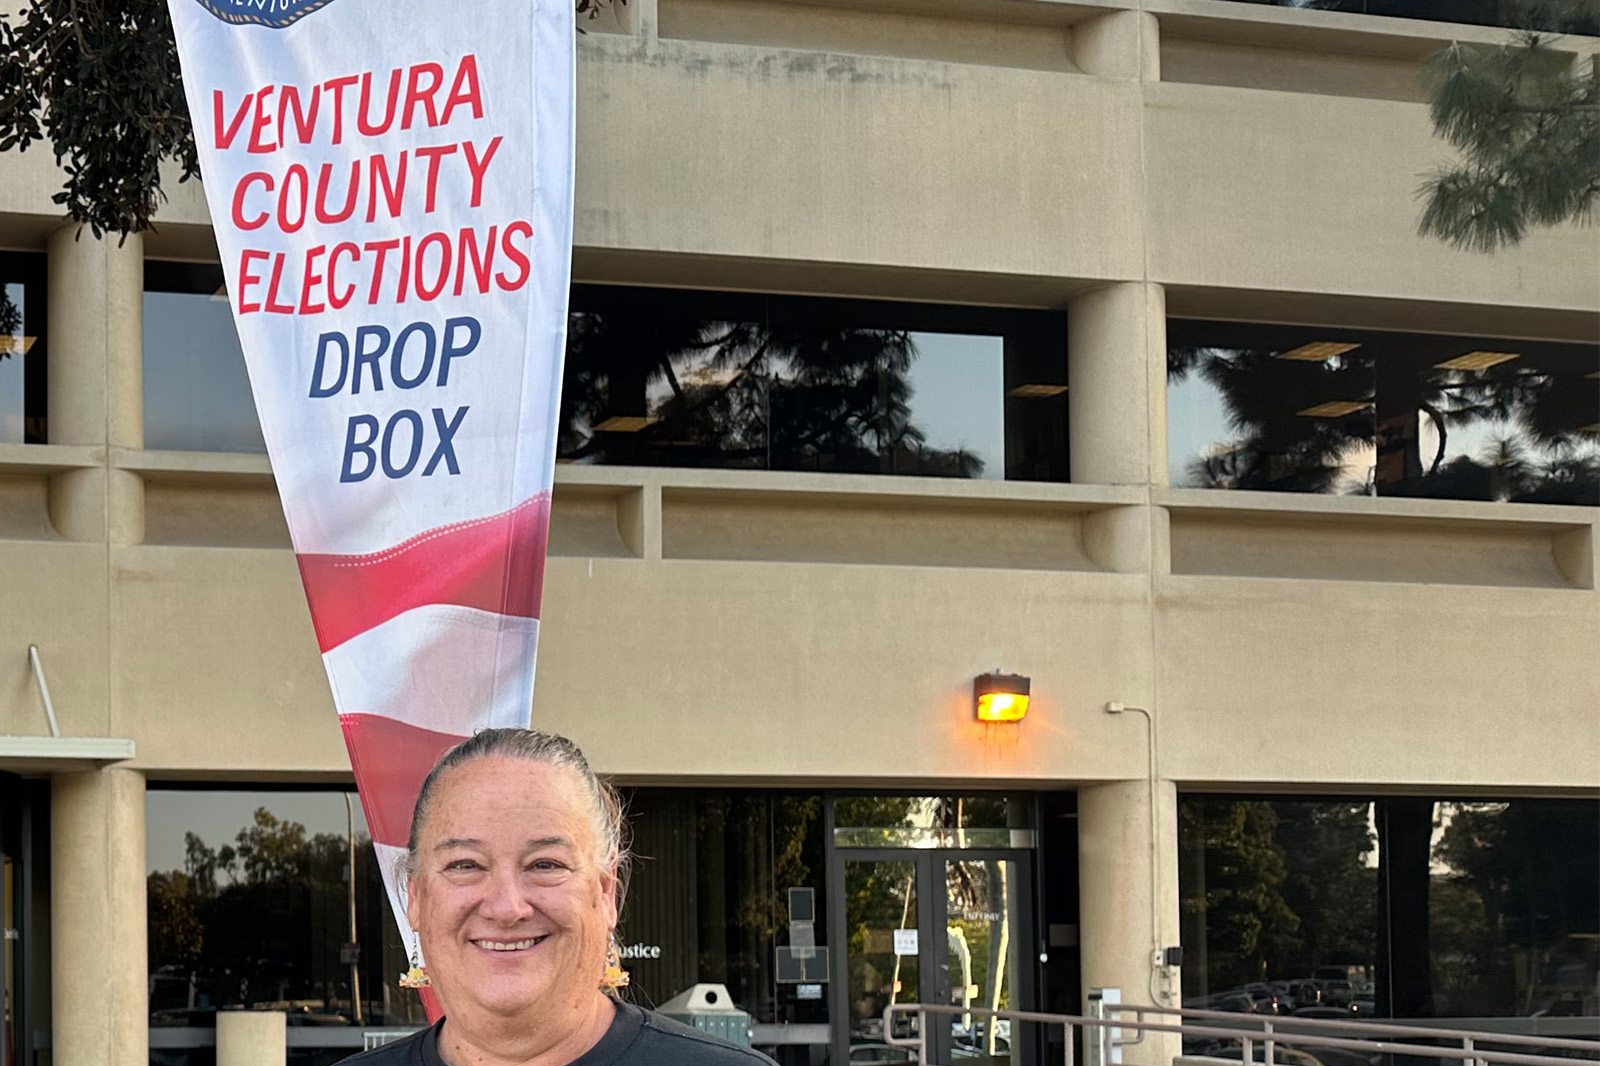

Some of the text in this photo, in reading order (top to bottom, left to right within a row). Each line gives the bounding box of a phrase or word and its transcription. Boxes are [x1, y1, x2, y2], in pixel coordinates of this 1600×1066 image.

[212, 54, 484, 154] VENTURA
[230, 136, 504, 233] COUNTY
[238, 221, 533, 316] ELECTIONS
[308, 316, 482, 399] DROP
[339, 406, 470, 483] BOX
[619, 942, 660, 958] ustice
